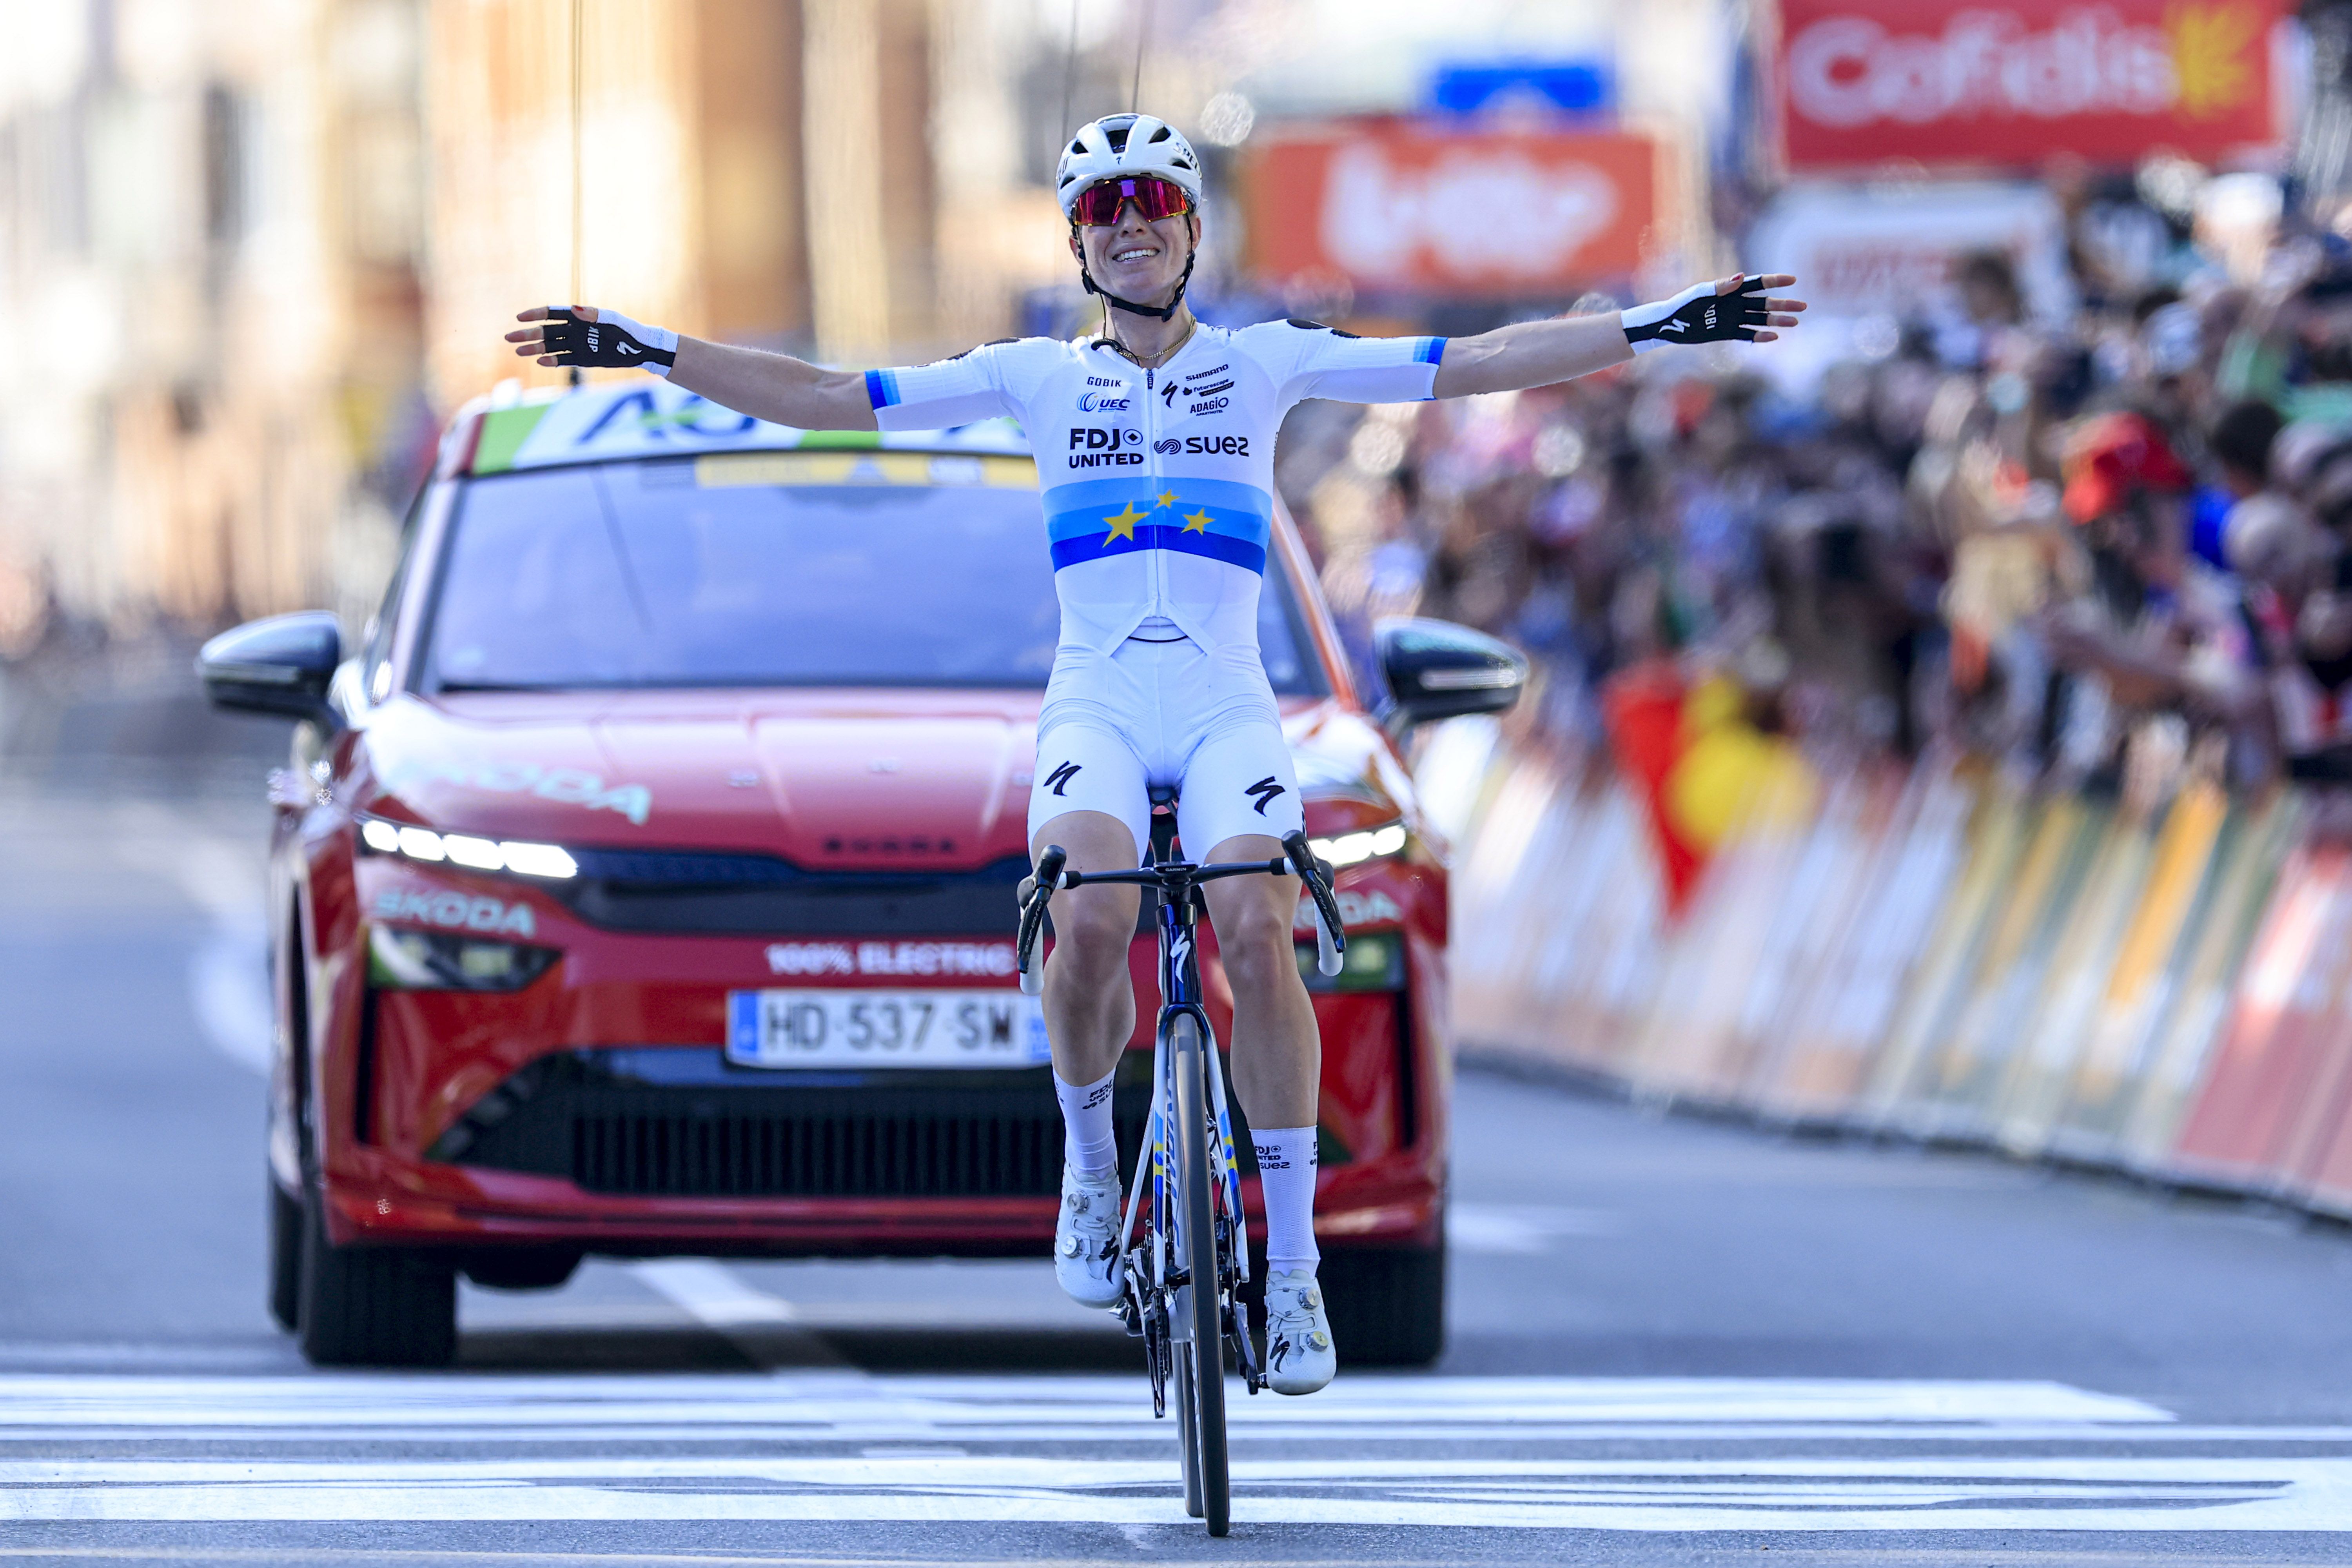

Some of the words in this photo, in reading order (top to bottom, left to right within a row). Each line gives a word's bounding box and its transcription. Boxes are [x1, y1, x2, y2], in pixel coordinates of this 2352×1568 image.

[1186, 364, 1229, 381] SHIMANO
[1087, 377, 1122, 387] GOBIK
[1194, 379, 1229, 392] futuroscope
[1100, 399, 1131, 408] UEC
[1070, 428, 1120, 451] FDJ
[1069, 453, 1144, 468] UNITED
[857, 943, 1016, 976] ELECTRIC
